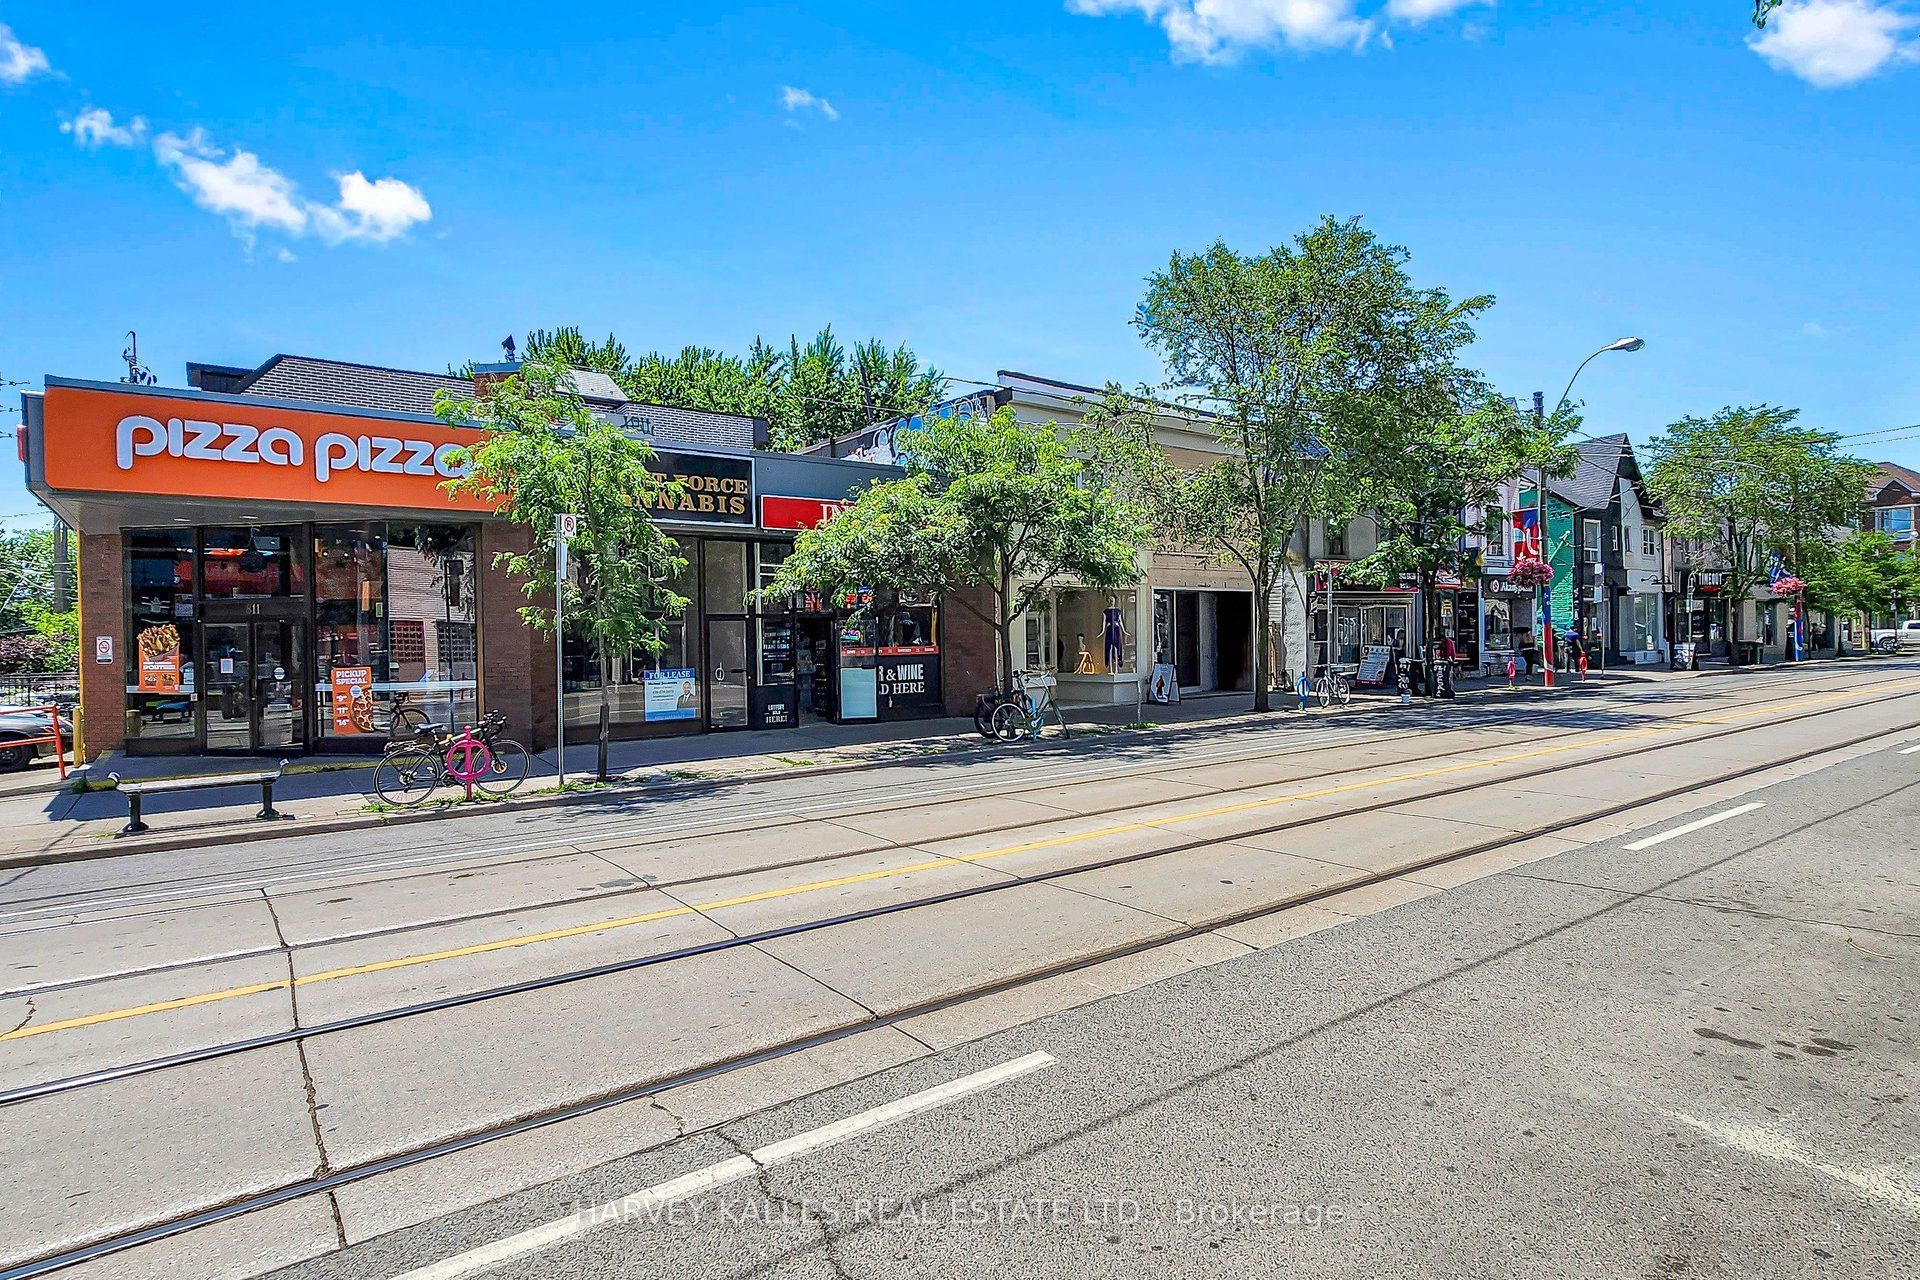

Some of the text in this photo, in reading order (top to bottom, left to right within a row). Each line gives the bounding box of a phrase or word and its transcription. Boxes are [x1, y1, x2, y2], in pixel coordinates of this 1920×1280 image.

[116, 415, 304, 470] pizza
[336, 670, 367, 678] PICKUP
[650, 670, 690, 679] FOR LEASE
[897, 664, 924, 680] WINE
[335, 677, 368, 685] SPECIAL
[893, 682, 925, 694] HERE
